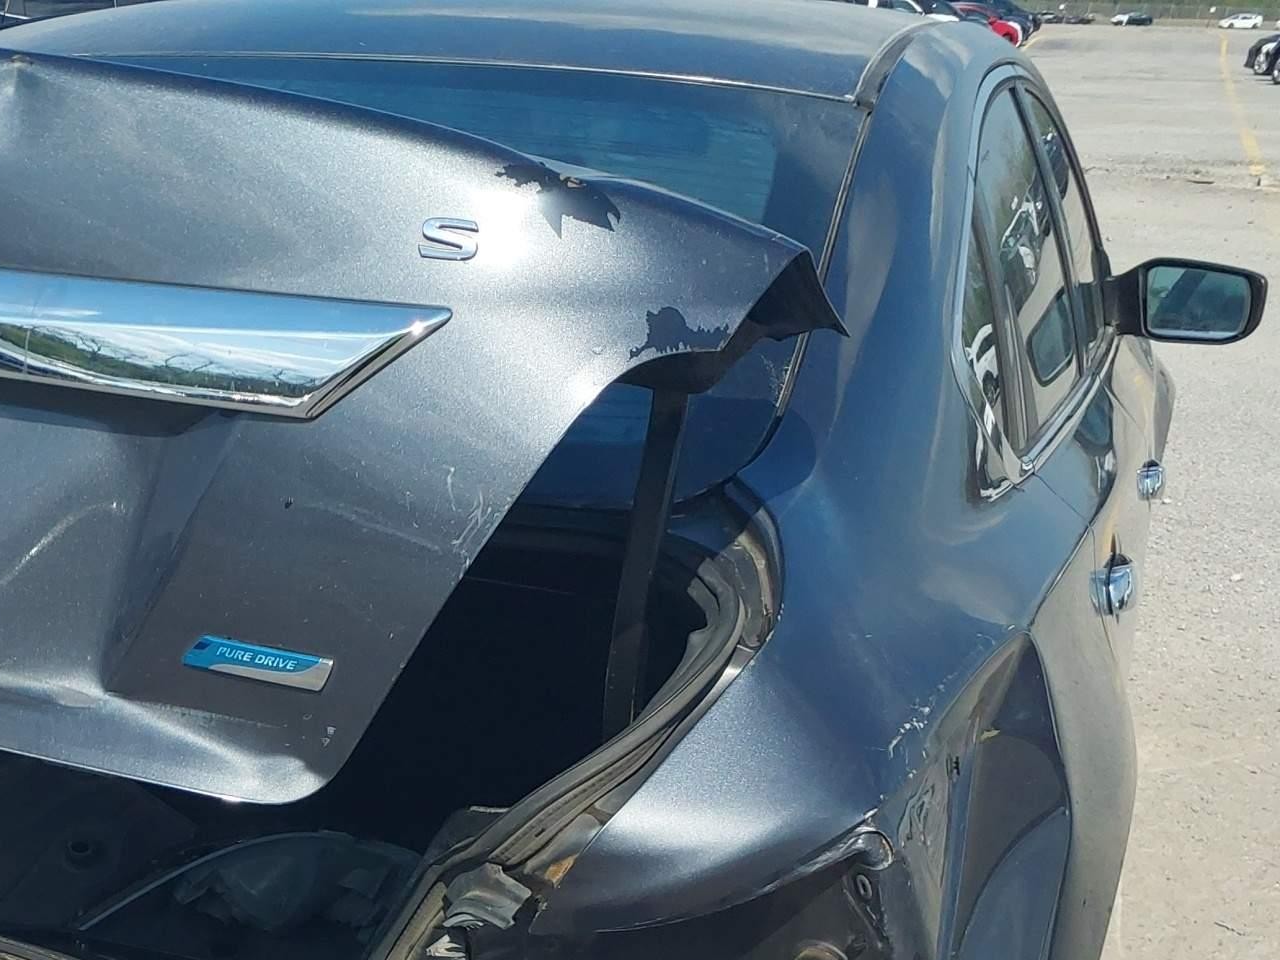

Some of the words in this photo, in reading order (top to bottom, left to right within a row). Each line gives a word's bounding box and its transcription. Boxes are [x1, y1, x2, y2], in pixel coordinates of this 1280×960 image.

[417, 217, 480, 262] S
[216, 646, 253, 662] PURE
[254, 654, 297, 670] DRIVE
